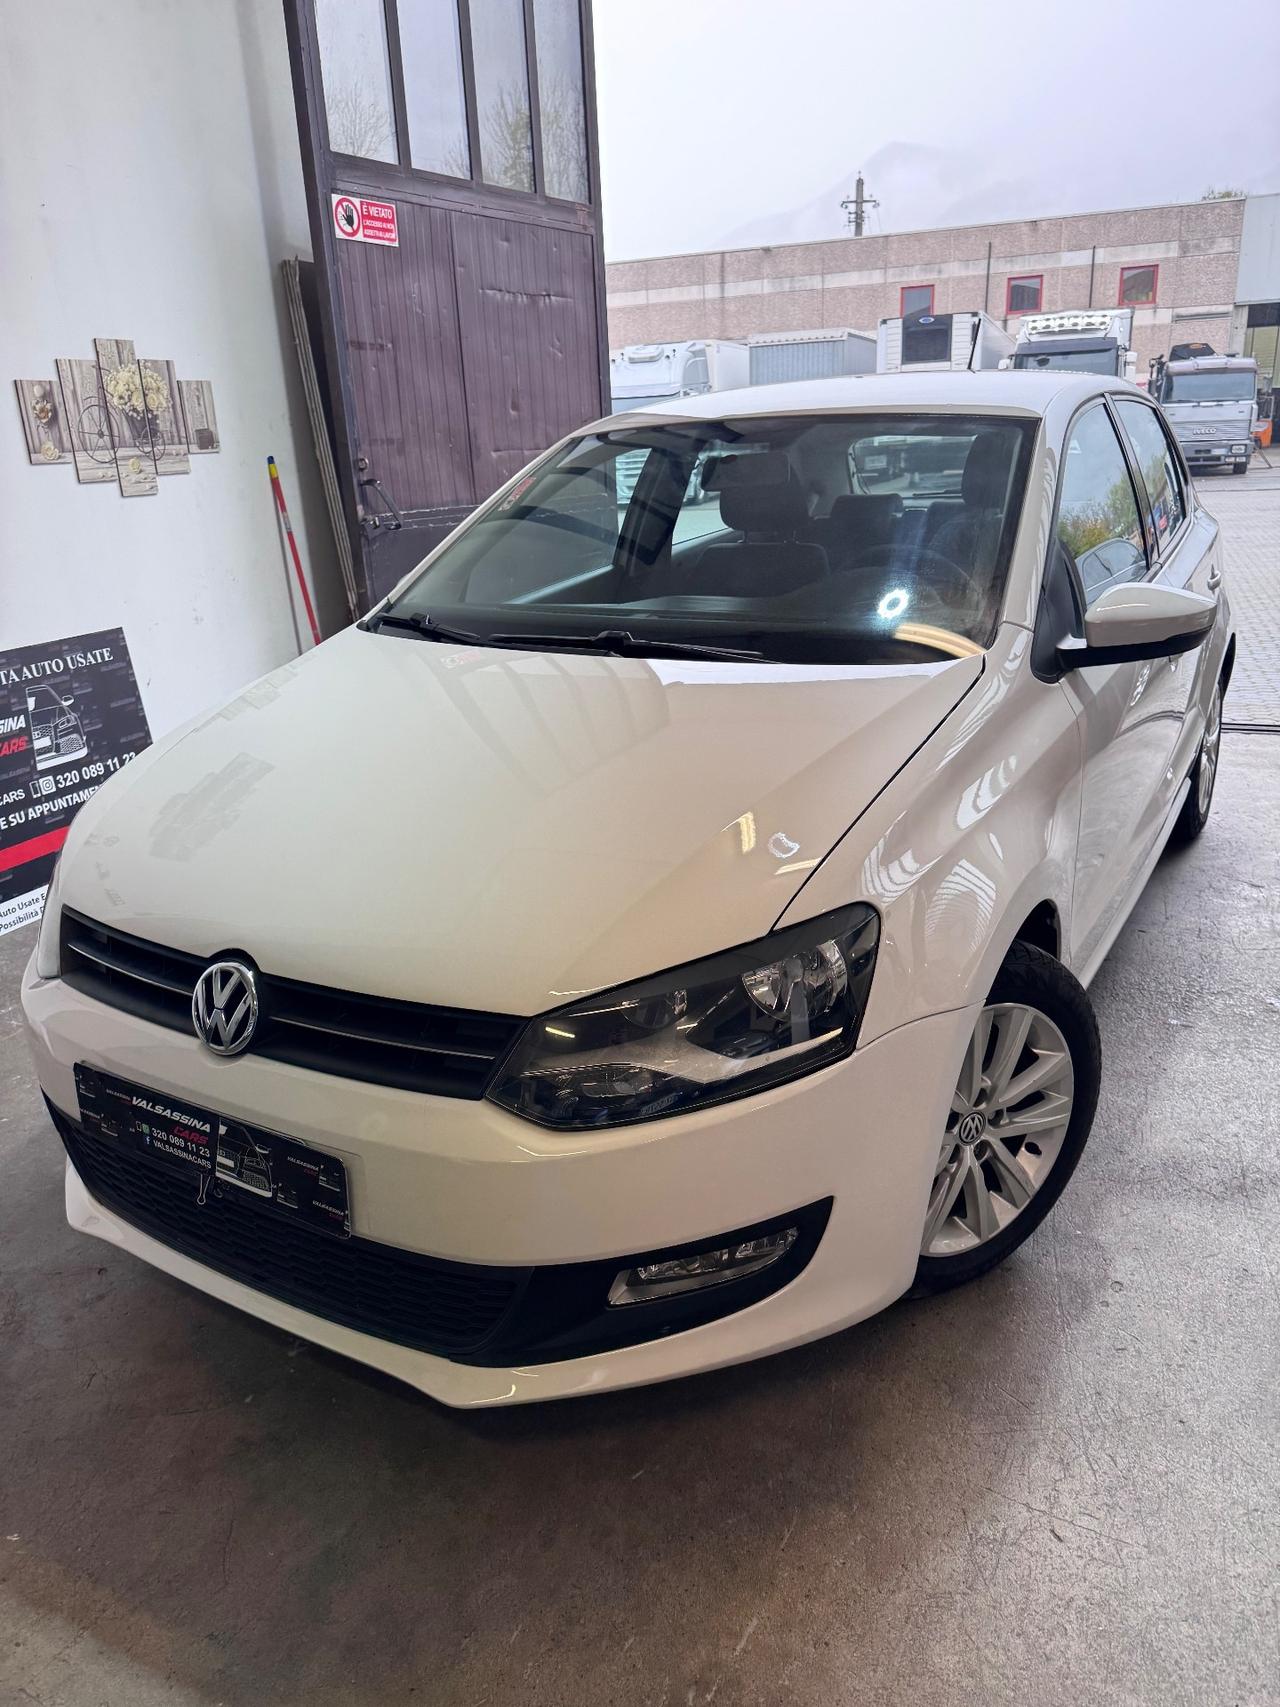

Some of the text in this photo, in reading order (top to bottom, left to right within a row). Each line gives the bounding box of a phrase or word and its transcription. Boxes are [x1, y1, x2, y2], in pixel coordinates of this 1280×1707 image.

[369, 206, 393, 219] VIETATO
[21, 658, 64, 681] AUTO
[66, 647, 114, 670] USATE
[0, 736, 28, 757] ARS
[56, 770, 80, 788] 320
[81, 762, 105, 780] 089
[106, 756, 120, 772] 11
[8, 810, 26, 827] SU
[28, 785, 99, 821] APPUNTAME
[17, 897, 40, 911] Usate
[132, 1096, 211, 1132] VALSASSINA
[151, 1127, 211, 1158] 320 089 11 23
[173, 1126, 209, 1145] CARS
[153, 1139, 212, 1169] VALSASSINACARS
